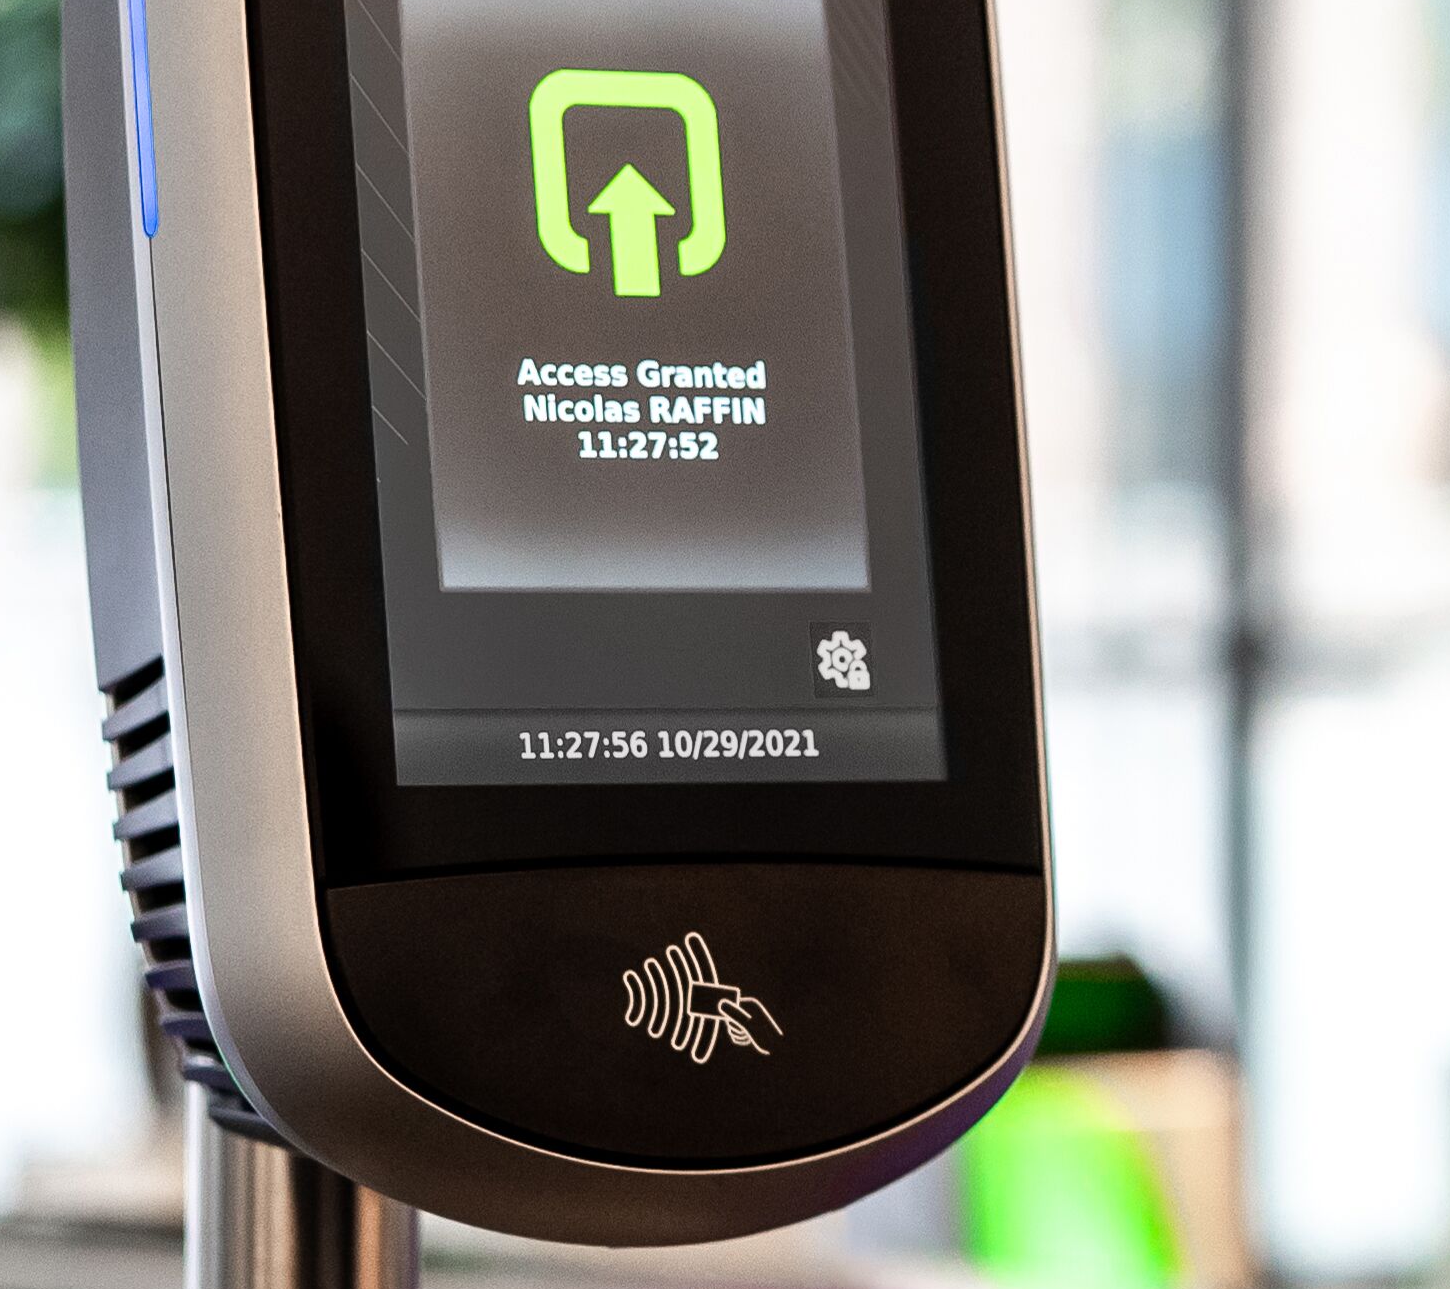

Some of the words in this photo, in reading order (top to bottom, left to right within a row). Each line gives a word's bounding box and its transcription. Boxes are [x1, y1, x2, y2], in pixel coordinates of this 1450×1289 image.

[517, 358, 628, 387] Access
[636, 360, 767, 390] Granted
[523, 393, 640, 423] Nicolas
[649, 396, 766, 425] RAFFIN
[577, 431, 719, 460] 11:27:52
[519, 730, 648, 760] 11:27:56
[657, 729, 820, 760] 10/29/2021
